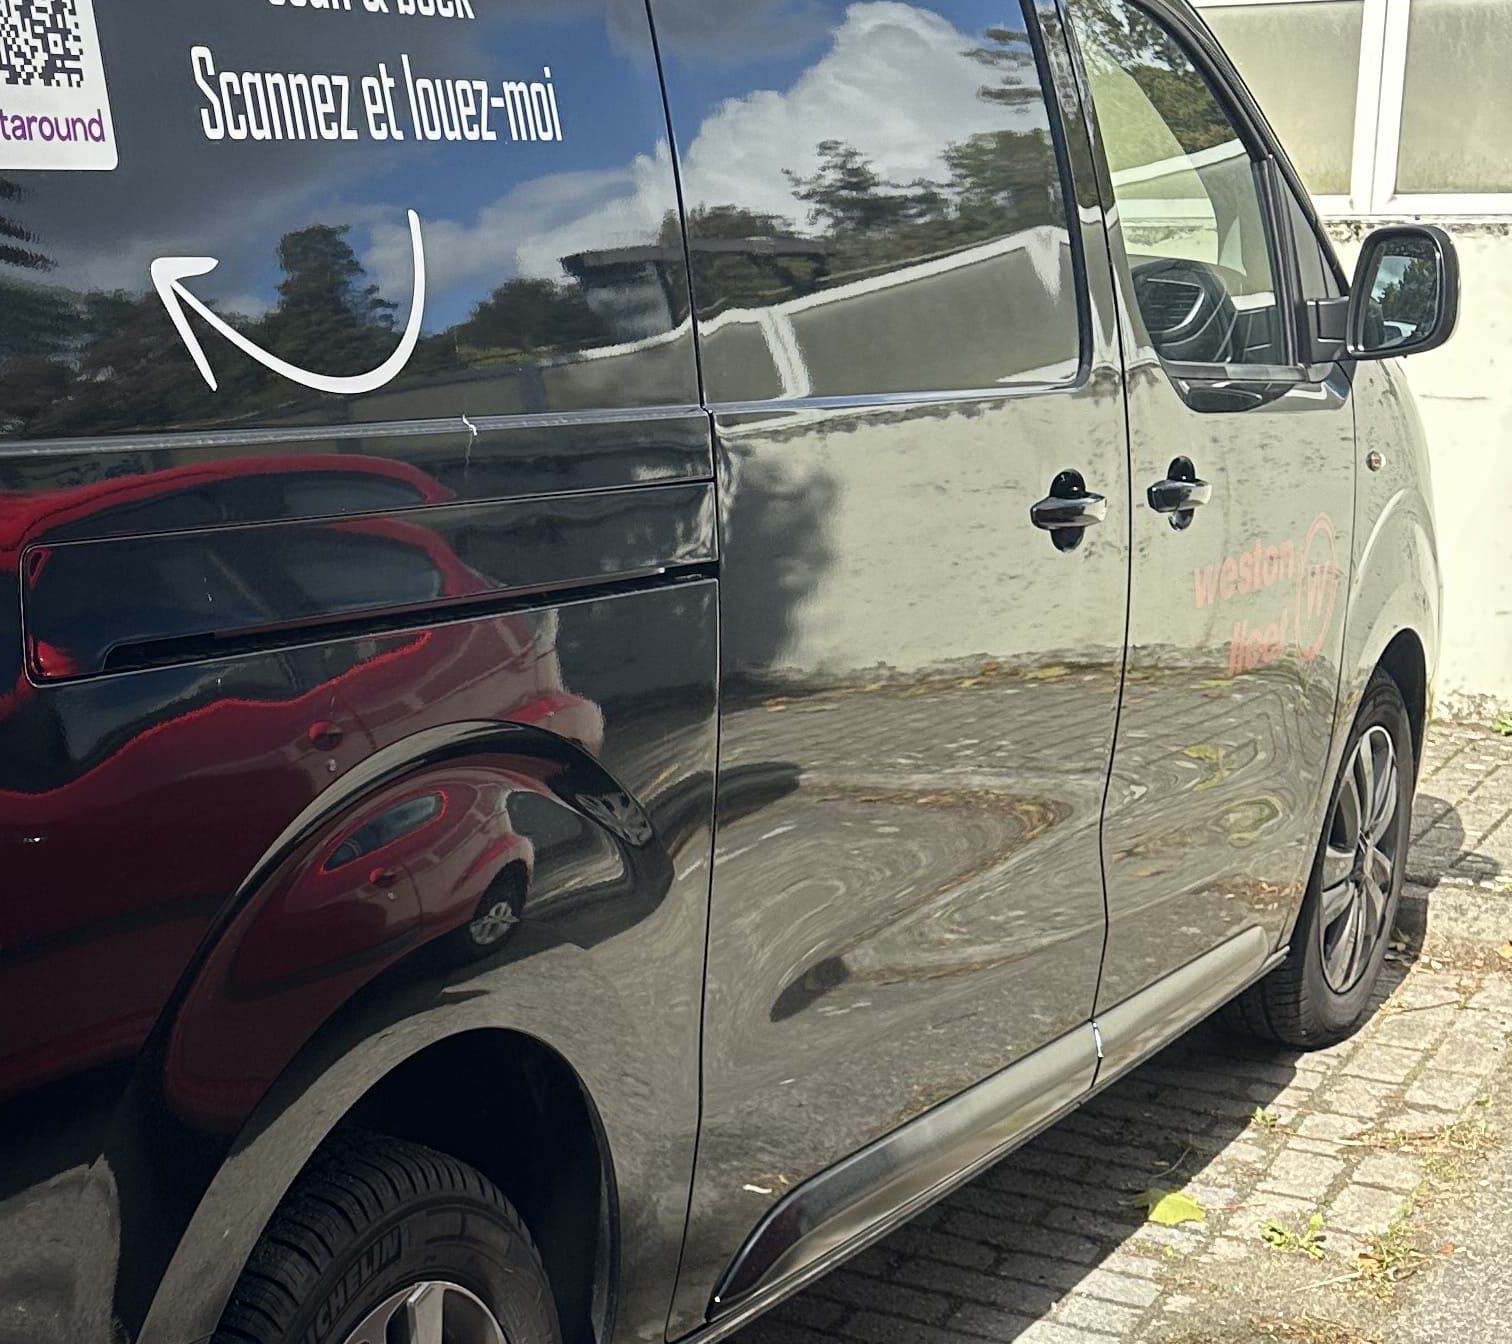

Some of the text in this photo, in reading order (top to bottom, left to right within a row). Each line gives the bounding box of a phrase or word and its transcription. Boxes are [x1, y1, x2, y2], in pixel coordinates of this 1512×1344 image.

[189, 44, 564, 143] Scannez et louez-moi
